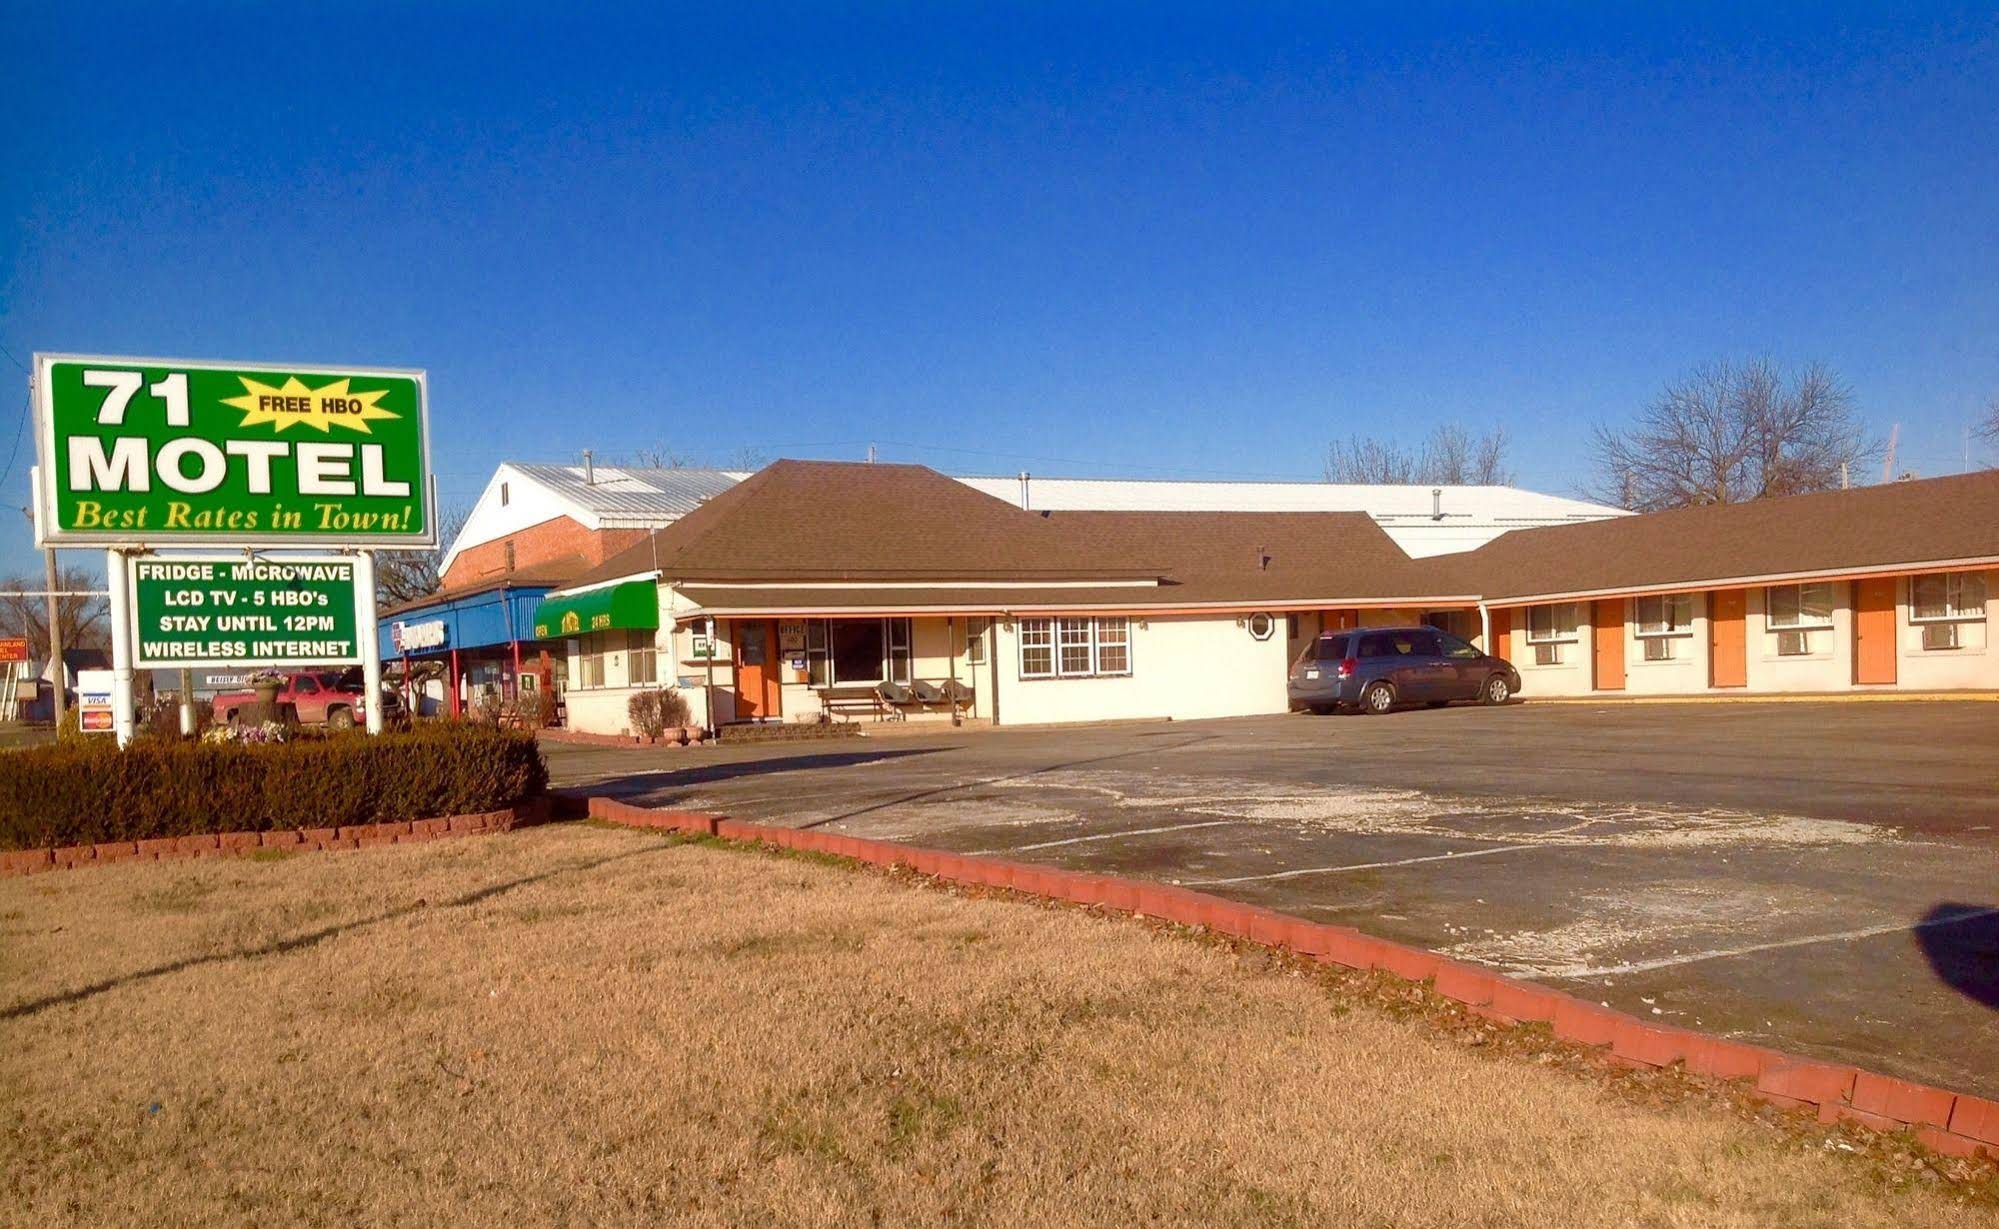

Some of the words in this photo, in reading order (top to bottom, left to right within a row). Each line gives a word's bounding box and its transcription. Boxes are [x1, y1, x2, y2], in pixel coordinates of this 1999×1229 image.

[82, 368, 190, 427] 71
[259, 395, 311, 414] FREE
[321, 397, 363, 416] HBO
[67, 436, 412, 497] MOTEL
[73, 501, 149, 529] Best
[165, 502, 259, 530] Rates
[272, 504, 302, 530] in
[314, 503, 412, 532] Town!
[139, 565, 214, 582] FRIDGE
[231, 565, 351, 582] MICROWAVE
[164, 590, 205, 607] LCD
[209, 590, 237, 607] TV
[253, 591, 266, 607] 5
[270, 590, 329, 607] HBO's
[159, 616, 211, 632] STAY
[216, 616, 278, 632] UNTIL
[283, 615, 335, 631] 12PM
[143, 641, 247, 657] WIRELESS
[252, 641, 351, 657] INTERNET
[87, 697, 107, 705] VISA
